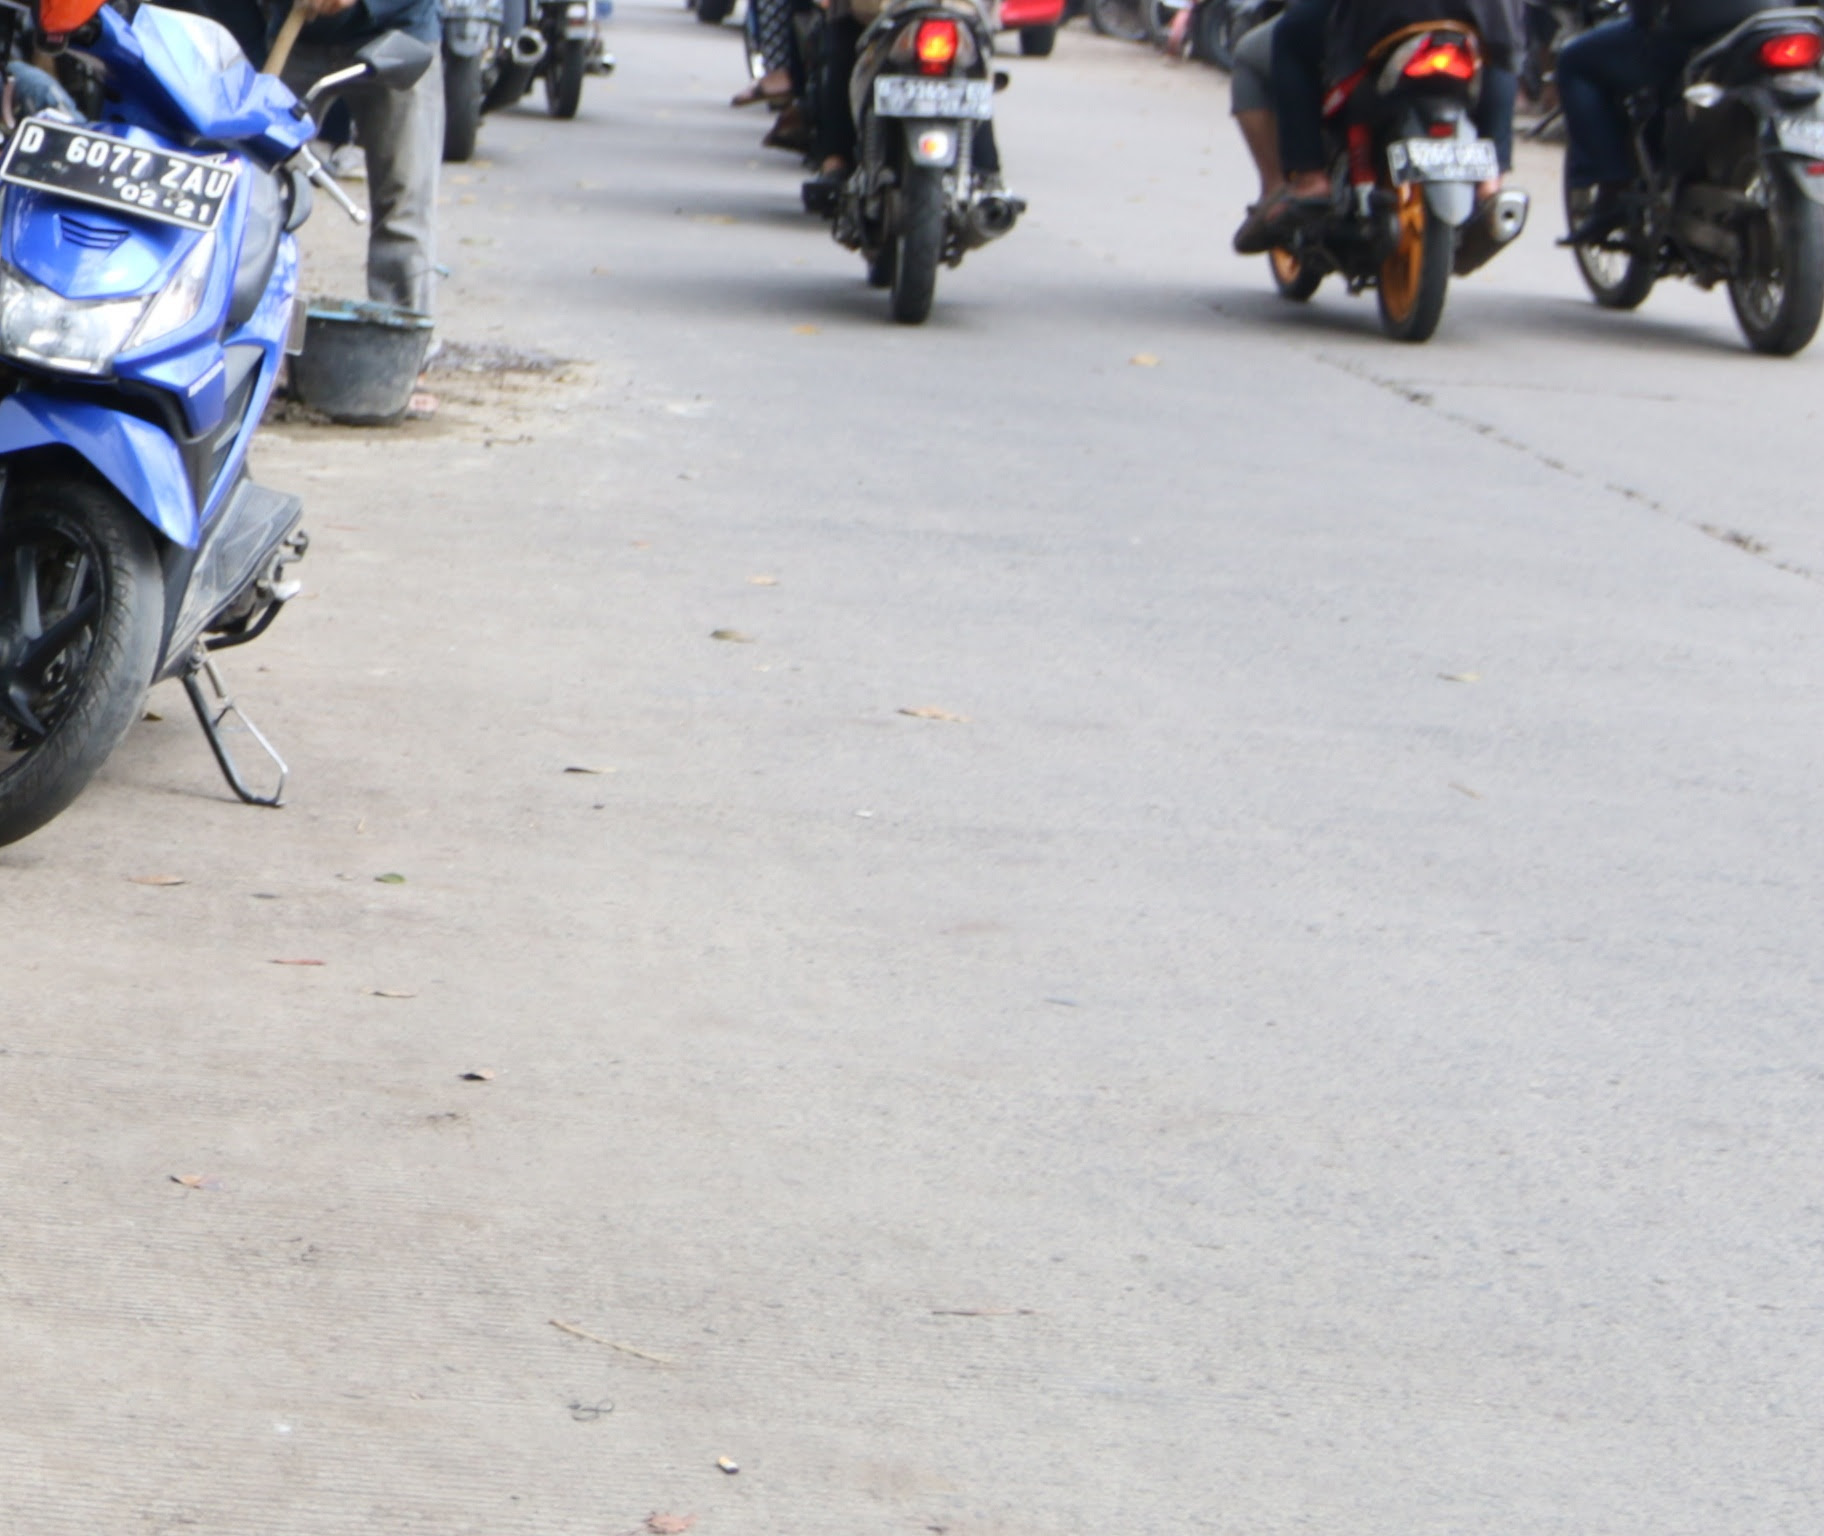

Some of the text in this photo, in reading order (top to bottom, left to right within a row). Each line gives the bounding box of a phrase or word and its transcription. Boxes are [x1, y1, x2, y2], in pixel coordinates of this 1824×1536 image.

[19, 126, 228, 199] D 6077 ZAU
